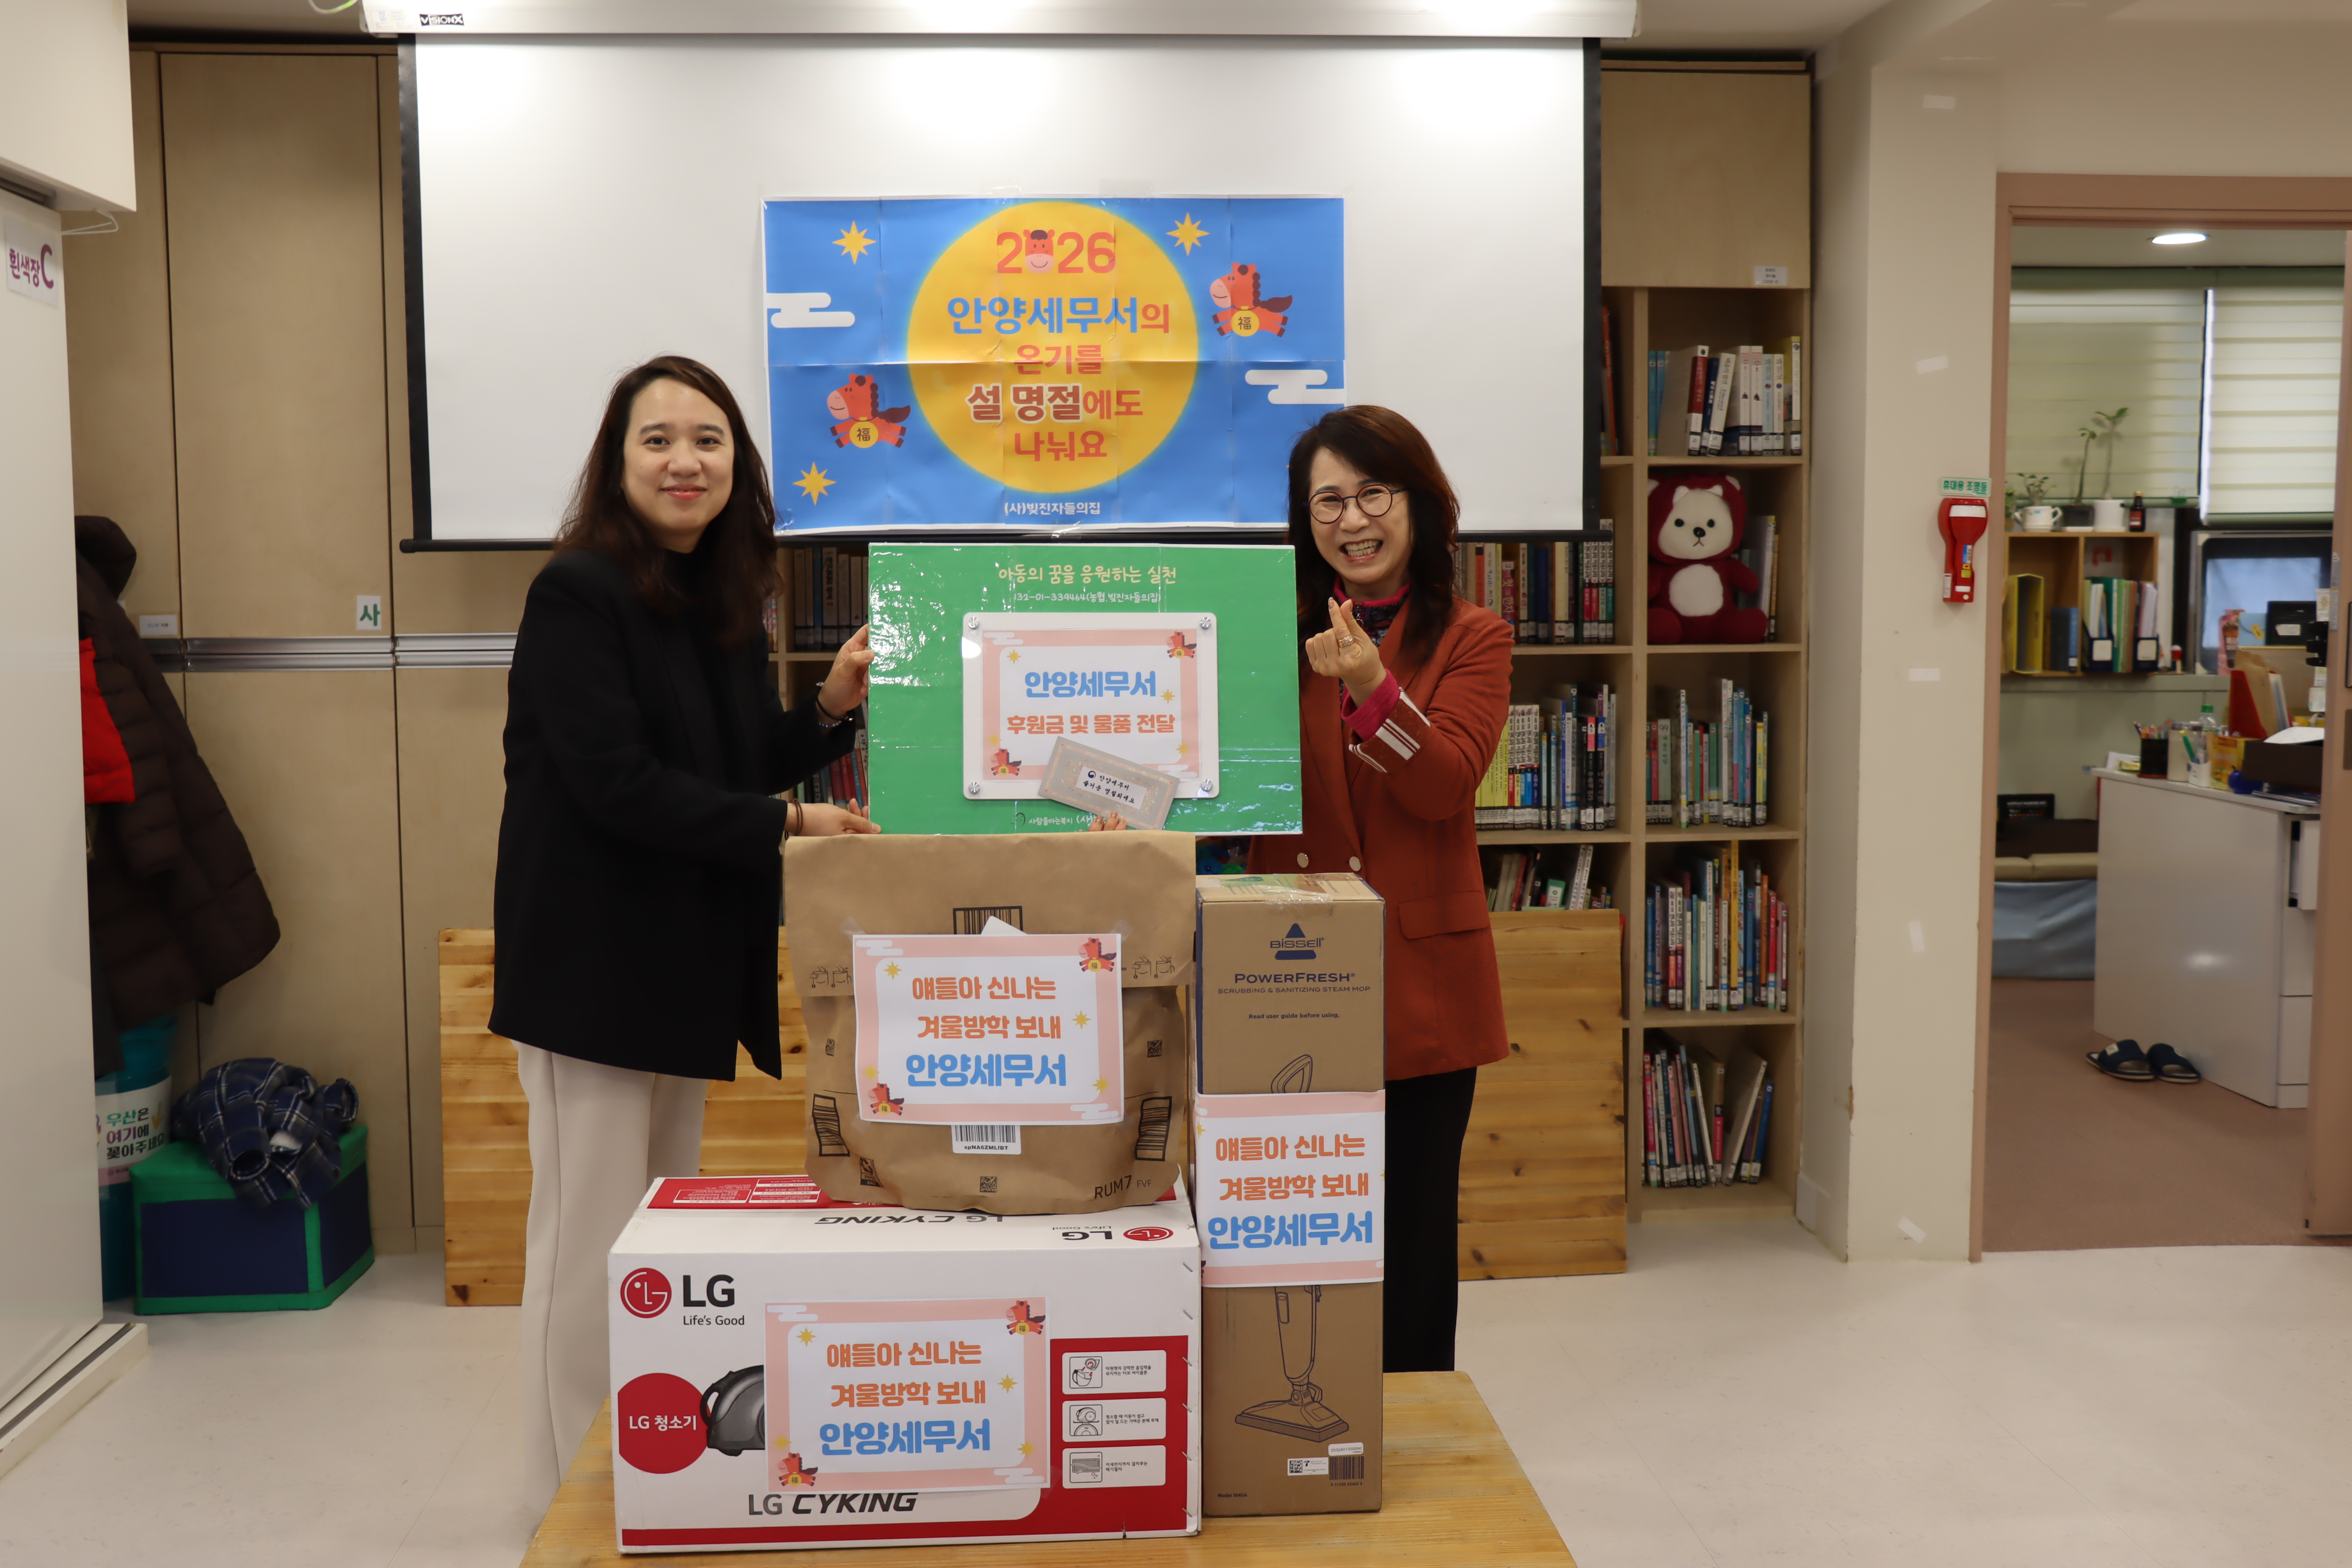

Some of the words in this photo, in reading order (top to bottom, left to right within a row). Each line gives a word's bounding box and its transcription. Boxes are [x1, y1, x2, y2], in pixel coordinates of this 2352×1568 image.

[947, 297, 1170, 334] 안양세무서의
[1238, 317, 1251, 330] 福
[1013, 344, 1104, 375] 온기를
[966, 384, 1002, 422] 설
[1011, 384, 1144, 422] 명절에도
[856, 427, 870, 441] 福
[1014, 430, 1107, 462] 나눠요
[1943, 480, 1964, 491] 휴대용
[1004, 502, 1101, 516] (사)빚진자들의집
[998, 564, 1043, 583] 아동의
[1049, 564, 1075, 584] 꿈을
[1080, 564, 1142, 584] 응원하는
[1147, 565, 1176, 584] 실천
[359, 603, 381, 627] 사
[1024, 670, 1156, 698] 안양세무서
[1006, 715, 1065, 735] 후원금
[1070, 714, 1089, 734] 및
[1094, 714, 1131, 734] 물품
[1136, 714, 1176, 734] 전달
[1083, 781, 1102, 791] 즐거운
[1104, 788, 1135, 804] 명절되세요
[1099, 775, 1129, 791] 안양세무서
[1028, 816, 1073, 826] 사람을아는복지
[912, 976, 983, 1001] 얘들아
[987, 976, 1056, 1000] 신나는
[917, 1015, 1010, 1039] 겨울방학
[1015, 1015, 1061, 1039] 보내
[906, 1053, 1067, 1087] 안양세무서
[106, 1107, 149, 1127] 우산은
[106, 1124, 149, 1145] 여기에
[1216, 1136, 1289, 1161] 얘들아
[1294, 1133, 1366, 1159] 신나는
[1094, 1174, 1132, 1200] RUM7
[1136, 1179, 1152, 1188] FVF
[1219, 1175, 1317, 1201] 겨울방학
[1321, 1172, 1369, 1197] 보내
[1061, 1231, 1113, 1240] LG
[1208, 1210, 1372, 1250] 안양세무서
[683, 1274, 735, 1308] LG
[683, 1315, 711, 1325] Life's
[715, 1315, 745, 1325] Good
[827, 1343, 903, 1368] 얘들아
[907, 1341, 982, 1365] 신나는
[831, 1382, 931, 1407] 겨울방학
[936, 1380, 985, 1404] 보내
[629, 1415, 650, 1429] LG
[654, 1415, 697, 1432] 청소기
[819, 1418, 990, 1455] 안양세무서
[748, 1494, 783, 1516] LG
[792, 1492, 919, 1514] CYKING
